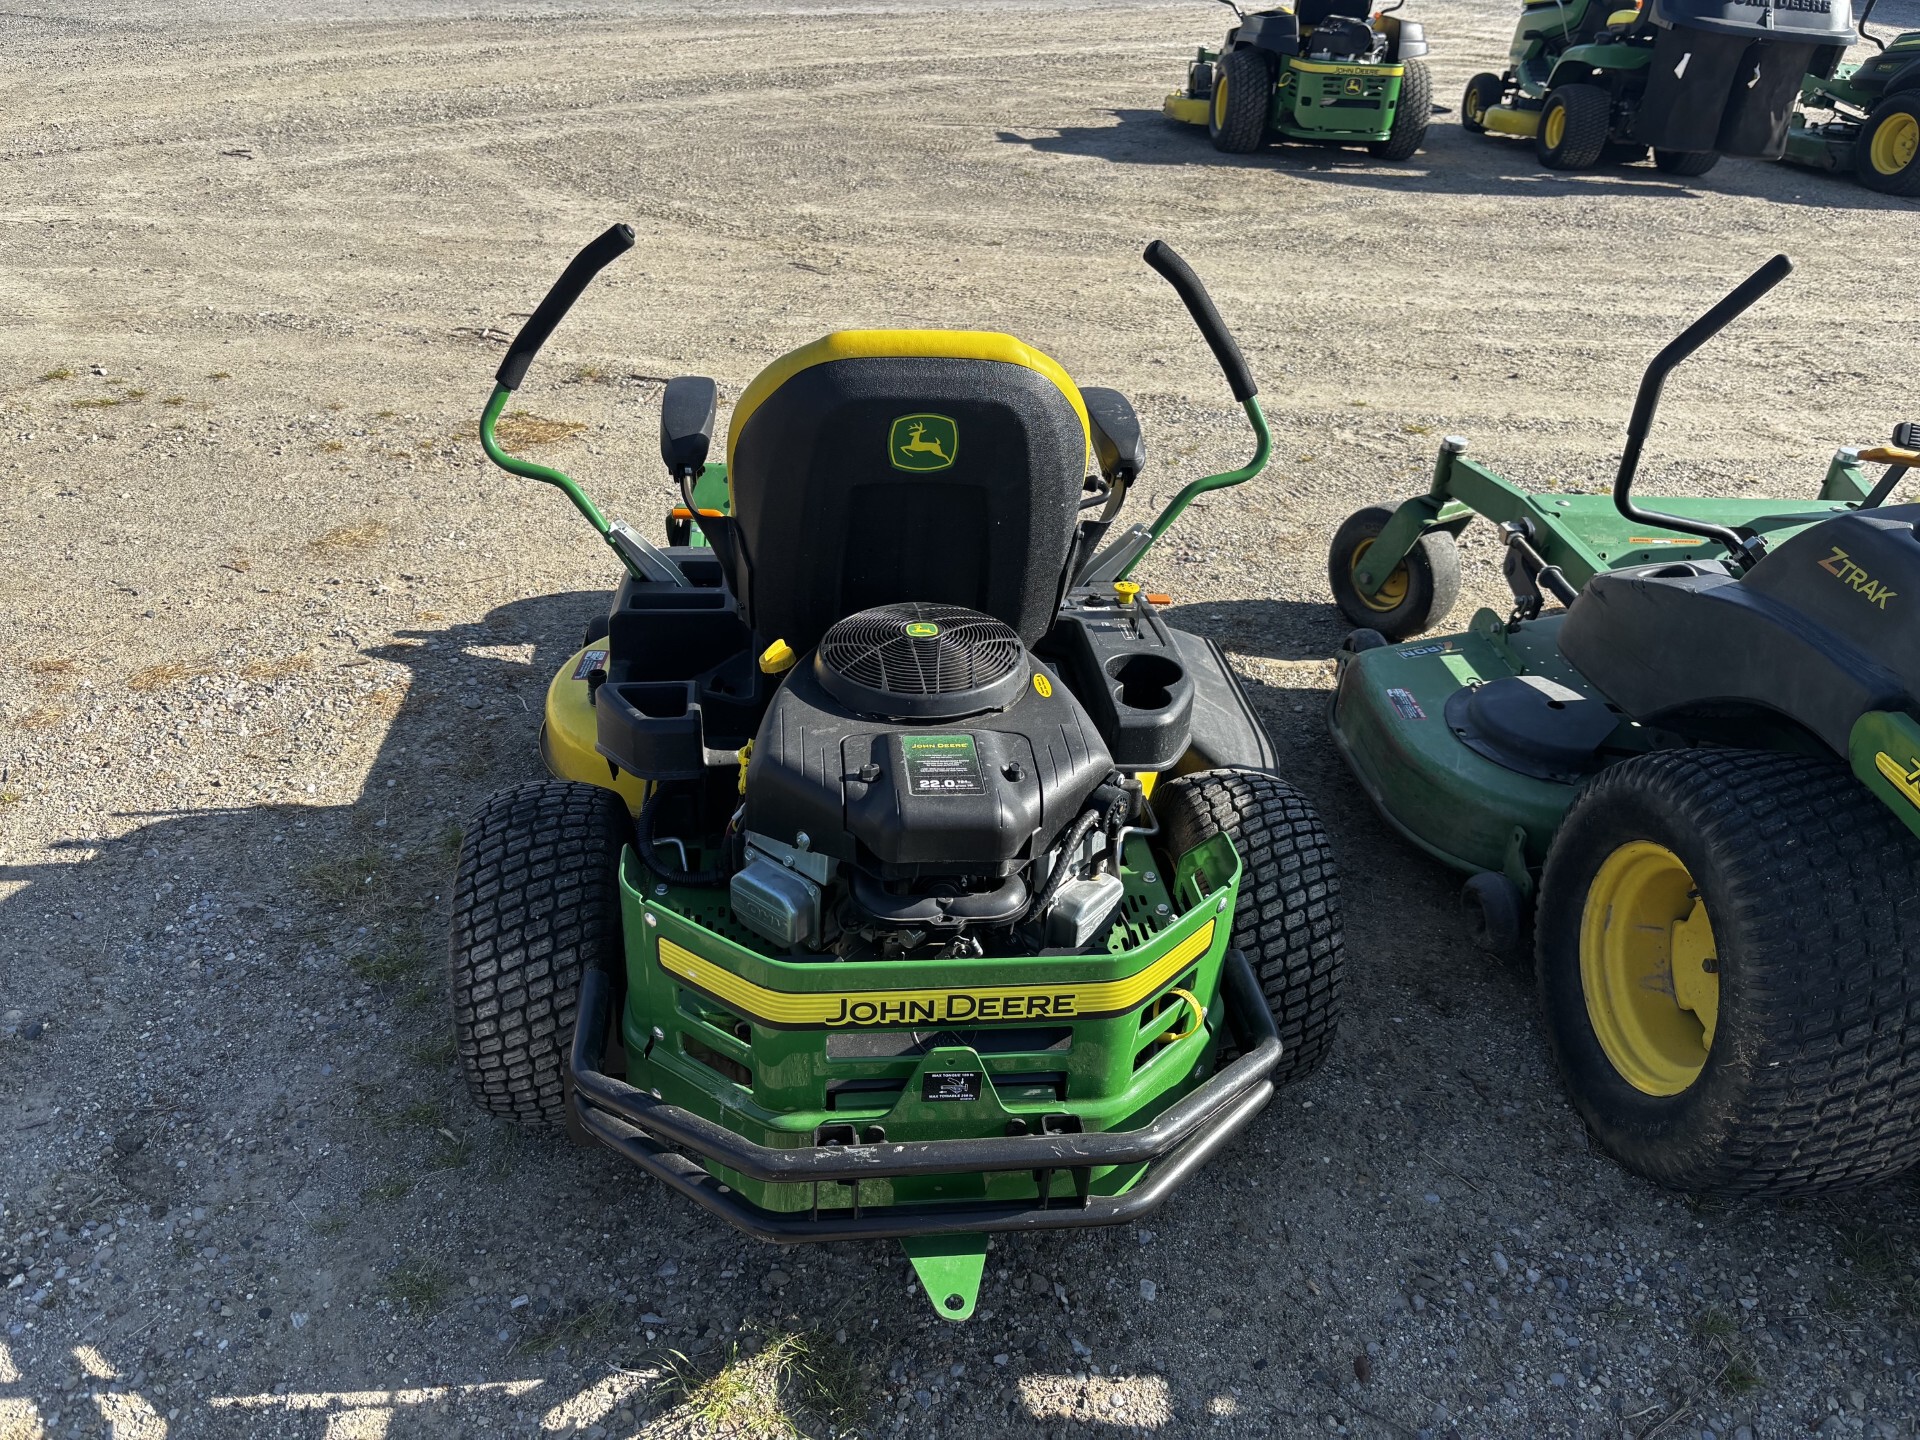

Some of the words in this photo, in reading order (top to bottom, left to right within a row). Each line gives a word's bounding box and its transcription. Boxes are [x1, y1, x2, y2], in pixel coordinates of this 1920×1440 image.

[1817, 546, 1899, 610] ZTRAK
[919, 779, 956, 788] 22.0
[825, 998, 936, 1024] JOHN
[946, 994, 1077, 1020] DEERE
